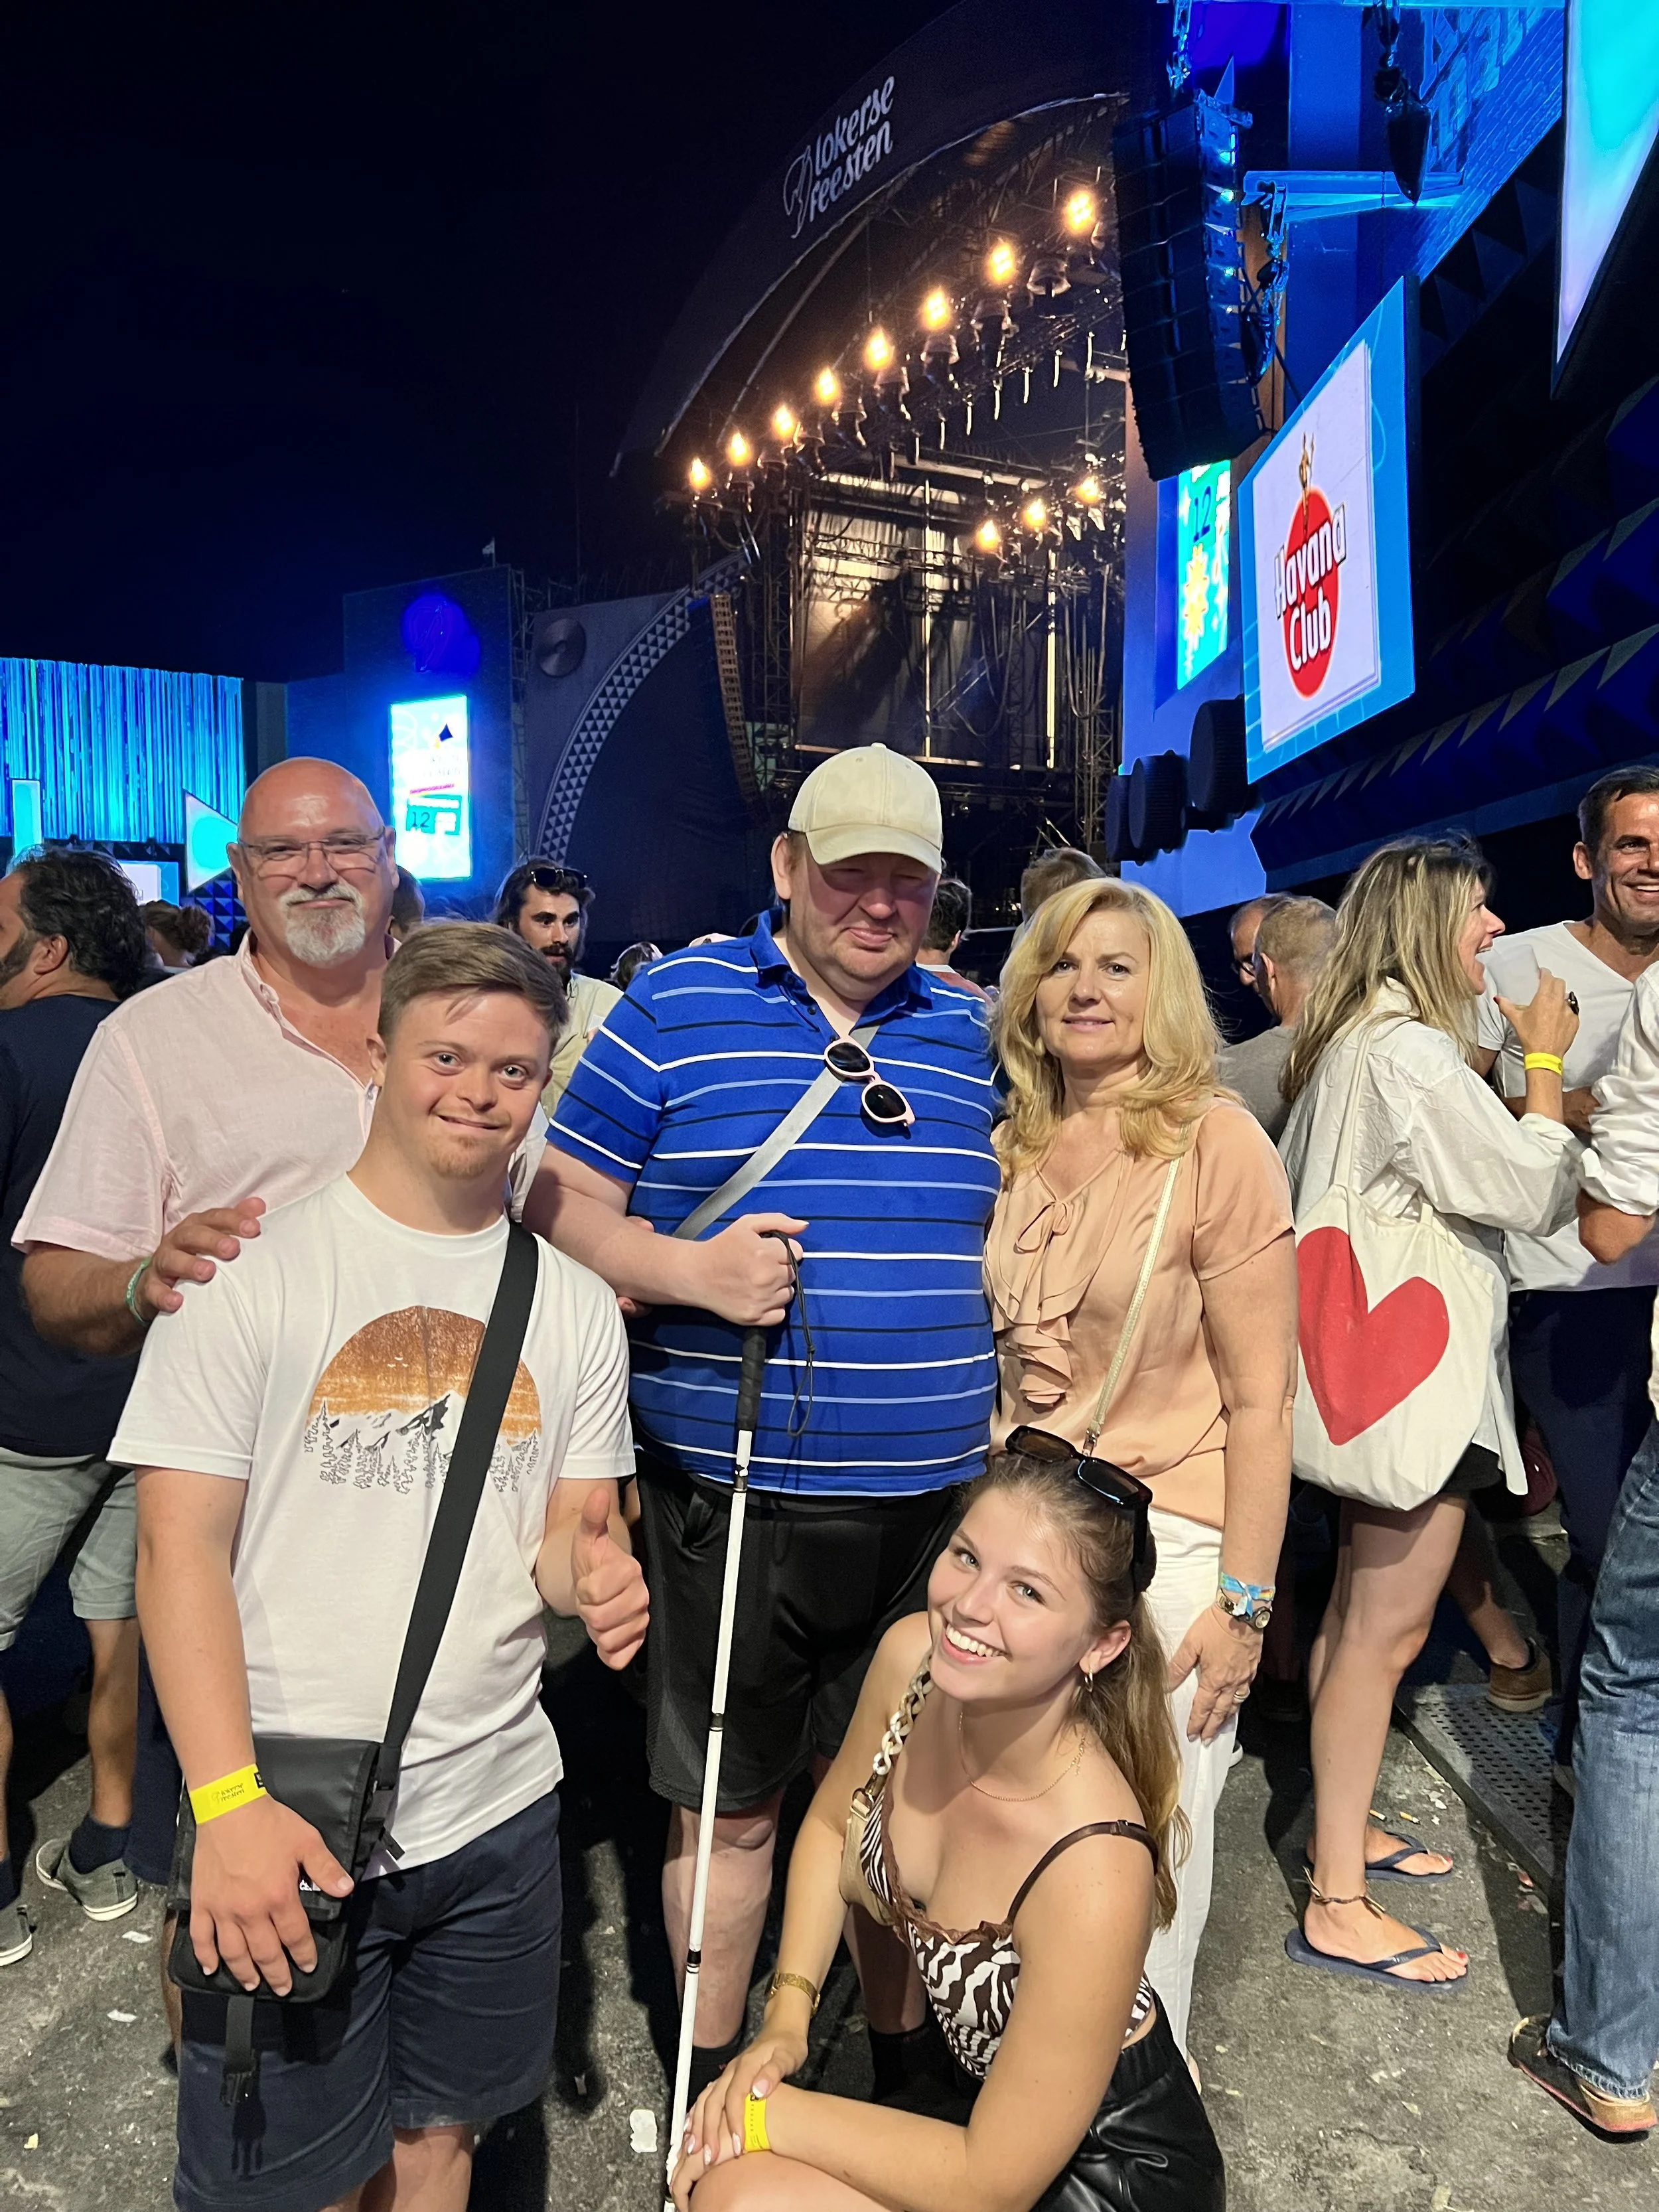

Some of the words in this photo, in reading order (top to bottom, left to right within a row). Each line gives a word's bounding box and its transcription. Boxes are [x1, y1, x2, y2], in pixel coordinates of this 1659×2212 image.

[1193, 485, 1211, 544] 12
[1273, 504, 1346, 621] Havana
[1289, 587, 1331, 672] Club
[412, 811, 430, 828] 12
